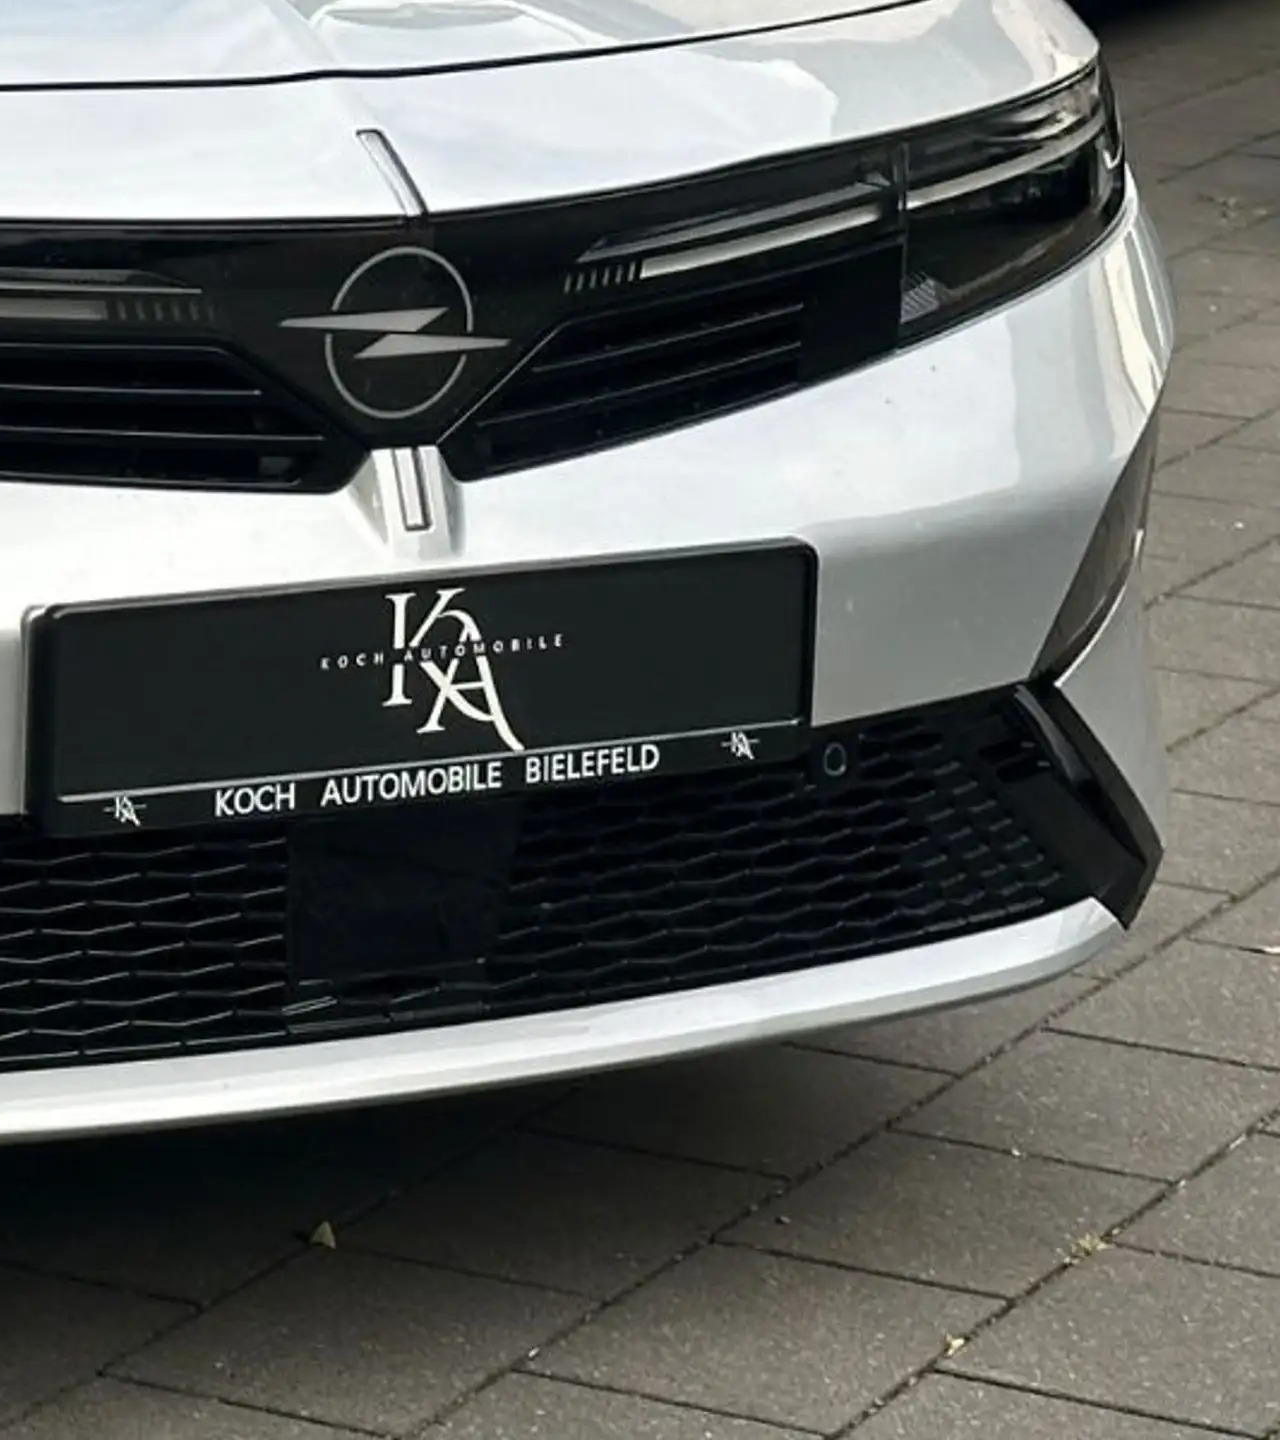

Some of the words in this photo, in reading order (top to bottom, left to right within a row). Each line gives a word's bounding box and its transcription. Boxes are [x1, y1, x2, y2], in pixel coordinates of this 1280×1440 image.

[320, 652, 385, 670] KOCH
[403, 633, 564, 662] AUTOMOBILE
[214, 782, 296, 817] KOCH
[320, 761, 502, 807] AUTOMOBILE
[525, 744, 660, 784] BIELEFELD
